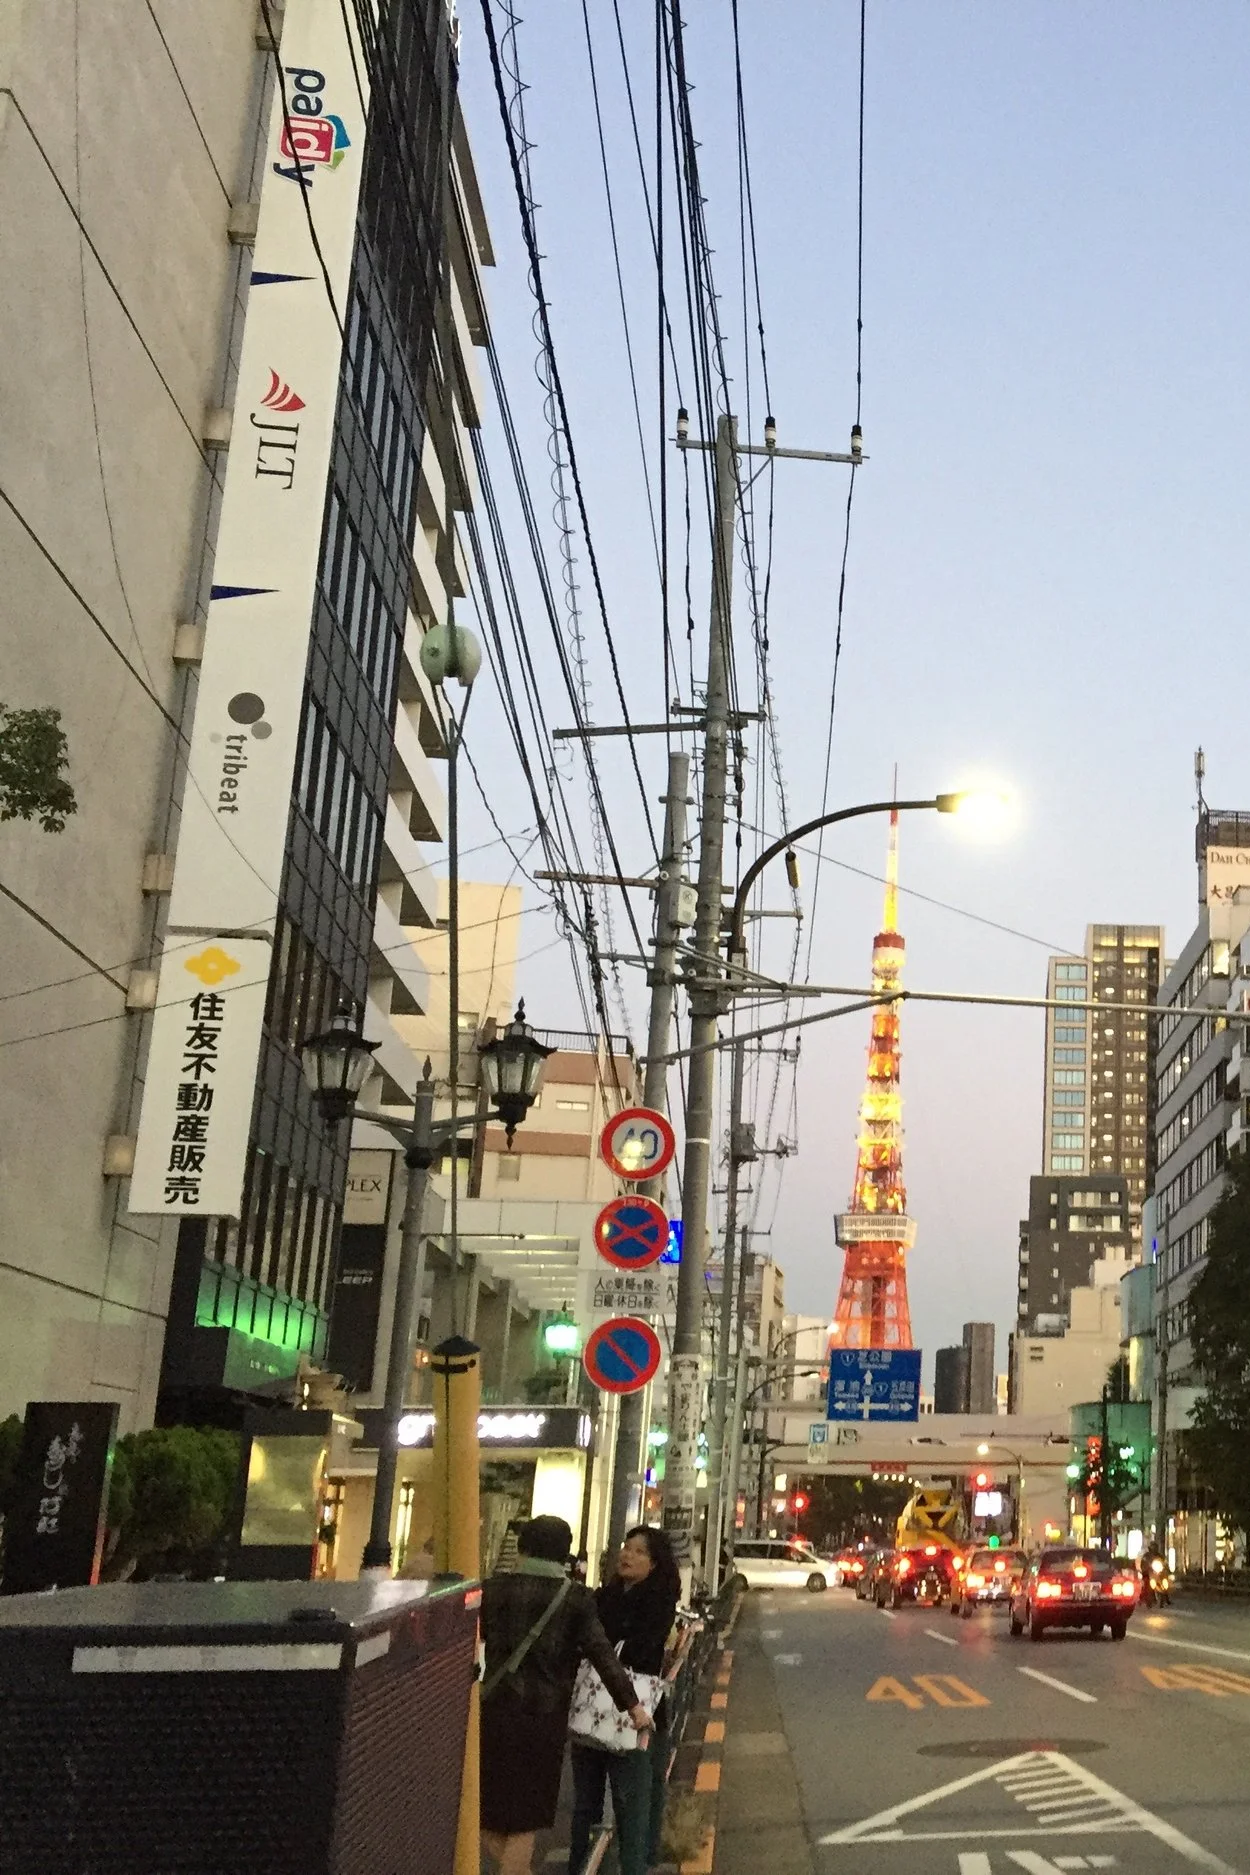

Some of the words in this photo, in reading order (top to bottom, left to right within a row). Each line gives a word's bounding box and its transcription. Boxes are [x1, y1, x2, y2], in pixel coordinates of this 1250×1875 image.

[272, 66, 328, 188] paidy
[249, 412, 300, 490] JLT
[217, 733, 248, 814] tribeat
[163, 991, 226, 1205] 住友不動産販売
[865, 1674, 991, 1709] 40
